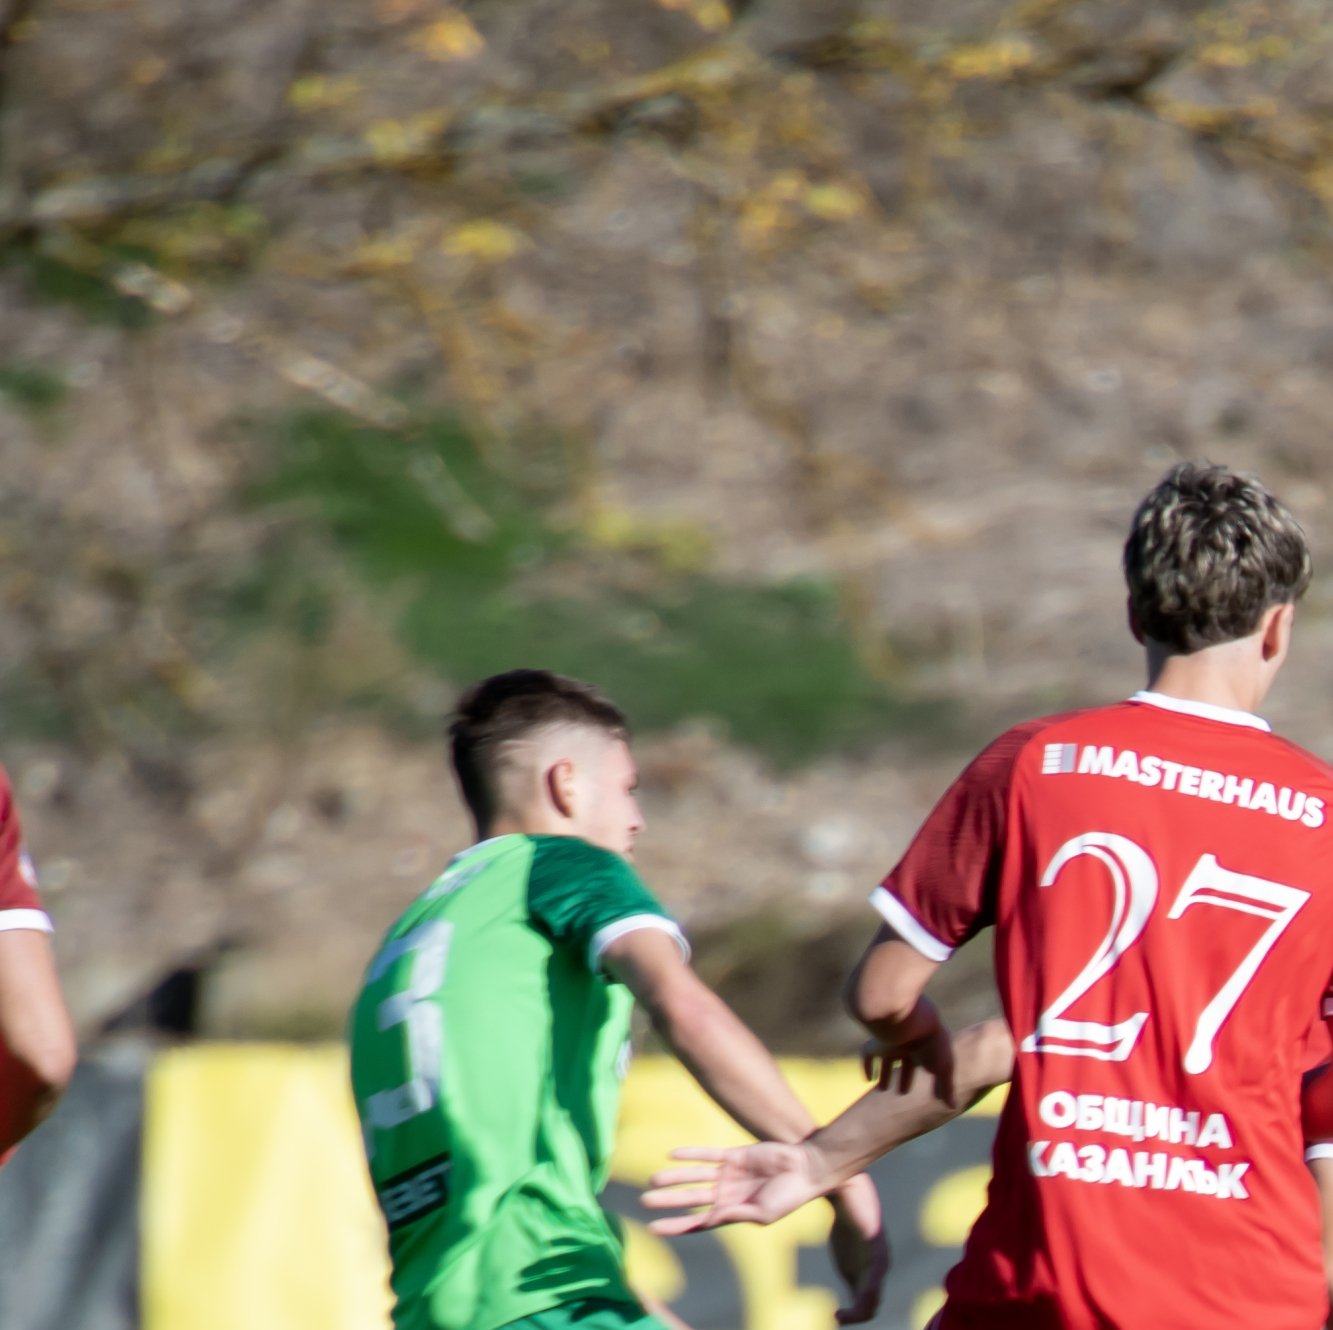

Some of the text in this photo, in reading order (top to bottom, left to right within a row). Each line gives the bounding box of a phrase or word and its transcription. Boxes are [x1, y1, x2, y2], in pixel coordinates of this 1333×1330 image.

[1078, 745, 1326, 828] MASTERHAUS
[1020, 831, 1311, 1075] 27
[1040, 1090, 1232, 1149] ОБЩИНА
[1028, 1140, 1249, 1200] КАЗАНЛЪК
